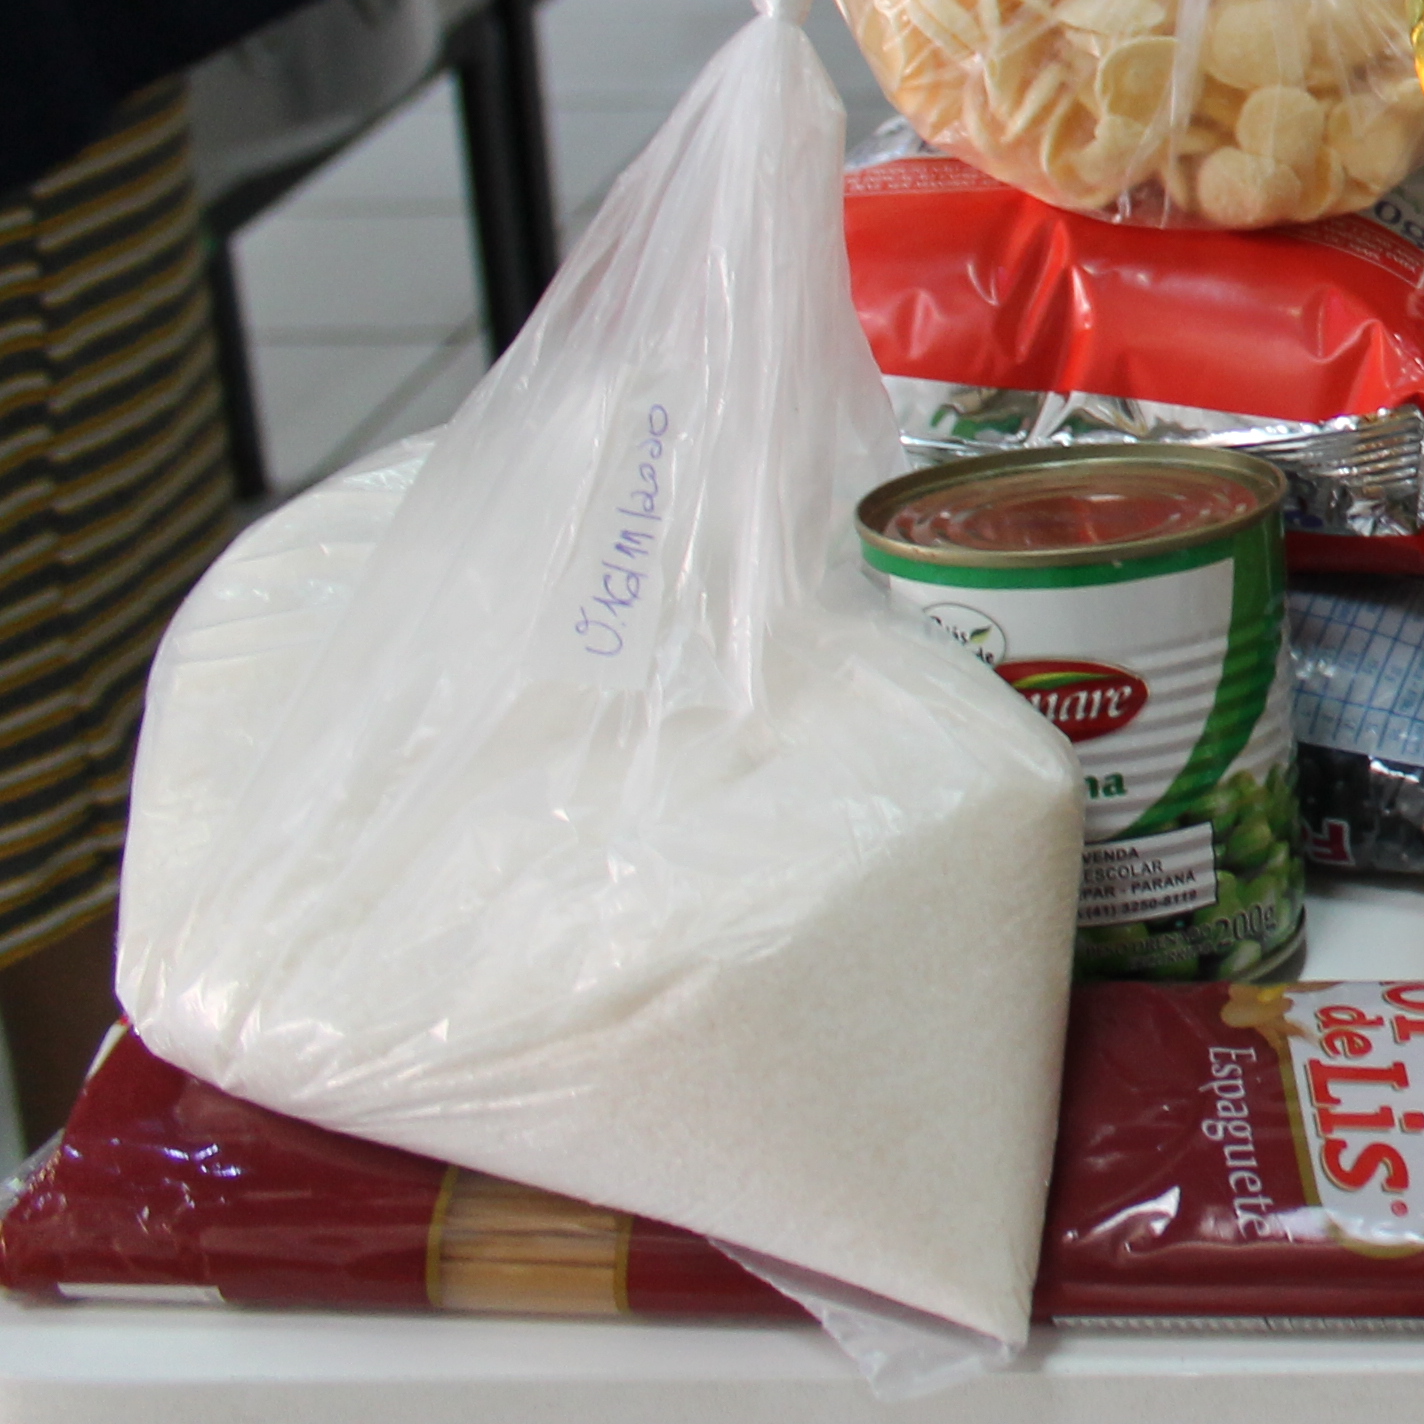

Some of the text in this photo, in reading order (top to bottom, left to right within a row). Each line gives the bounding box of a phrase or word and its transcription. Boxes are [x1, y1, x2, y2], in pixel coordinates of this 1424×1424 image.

[1082, 846, 1140, 865] VENDA
[1084, 859, 1165, 884] ESCOLAR
[1314, 1004, 1386, 1059] de
[1198, 1045, 1275, 1243] Espaguete
